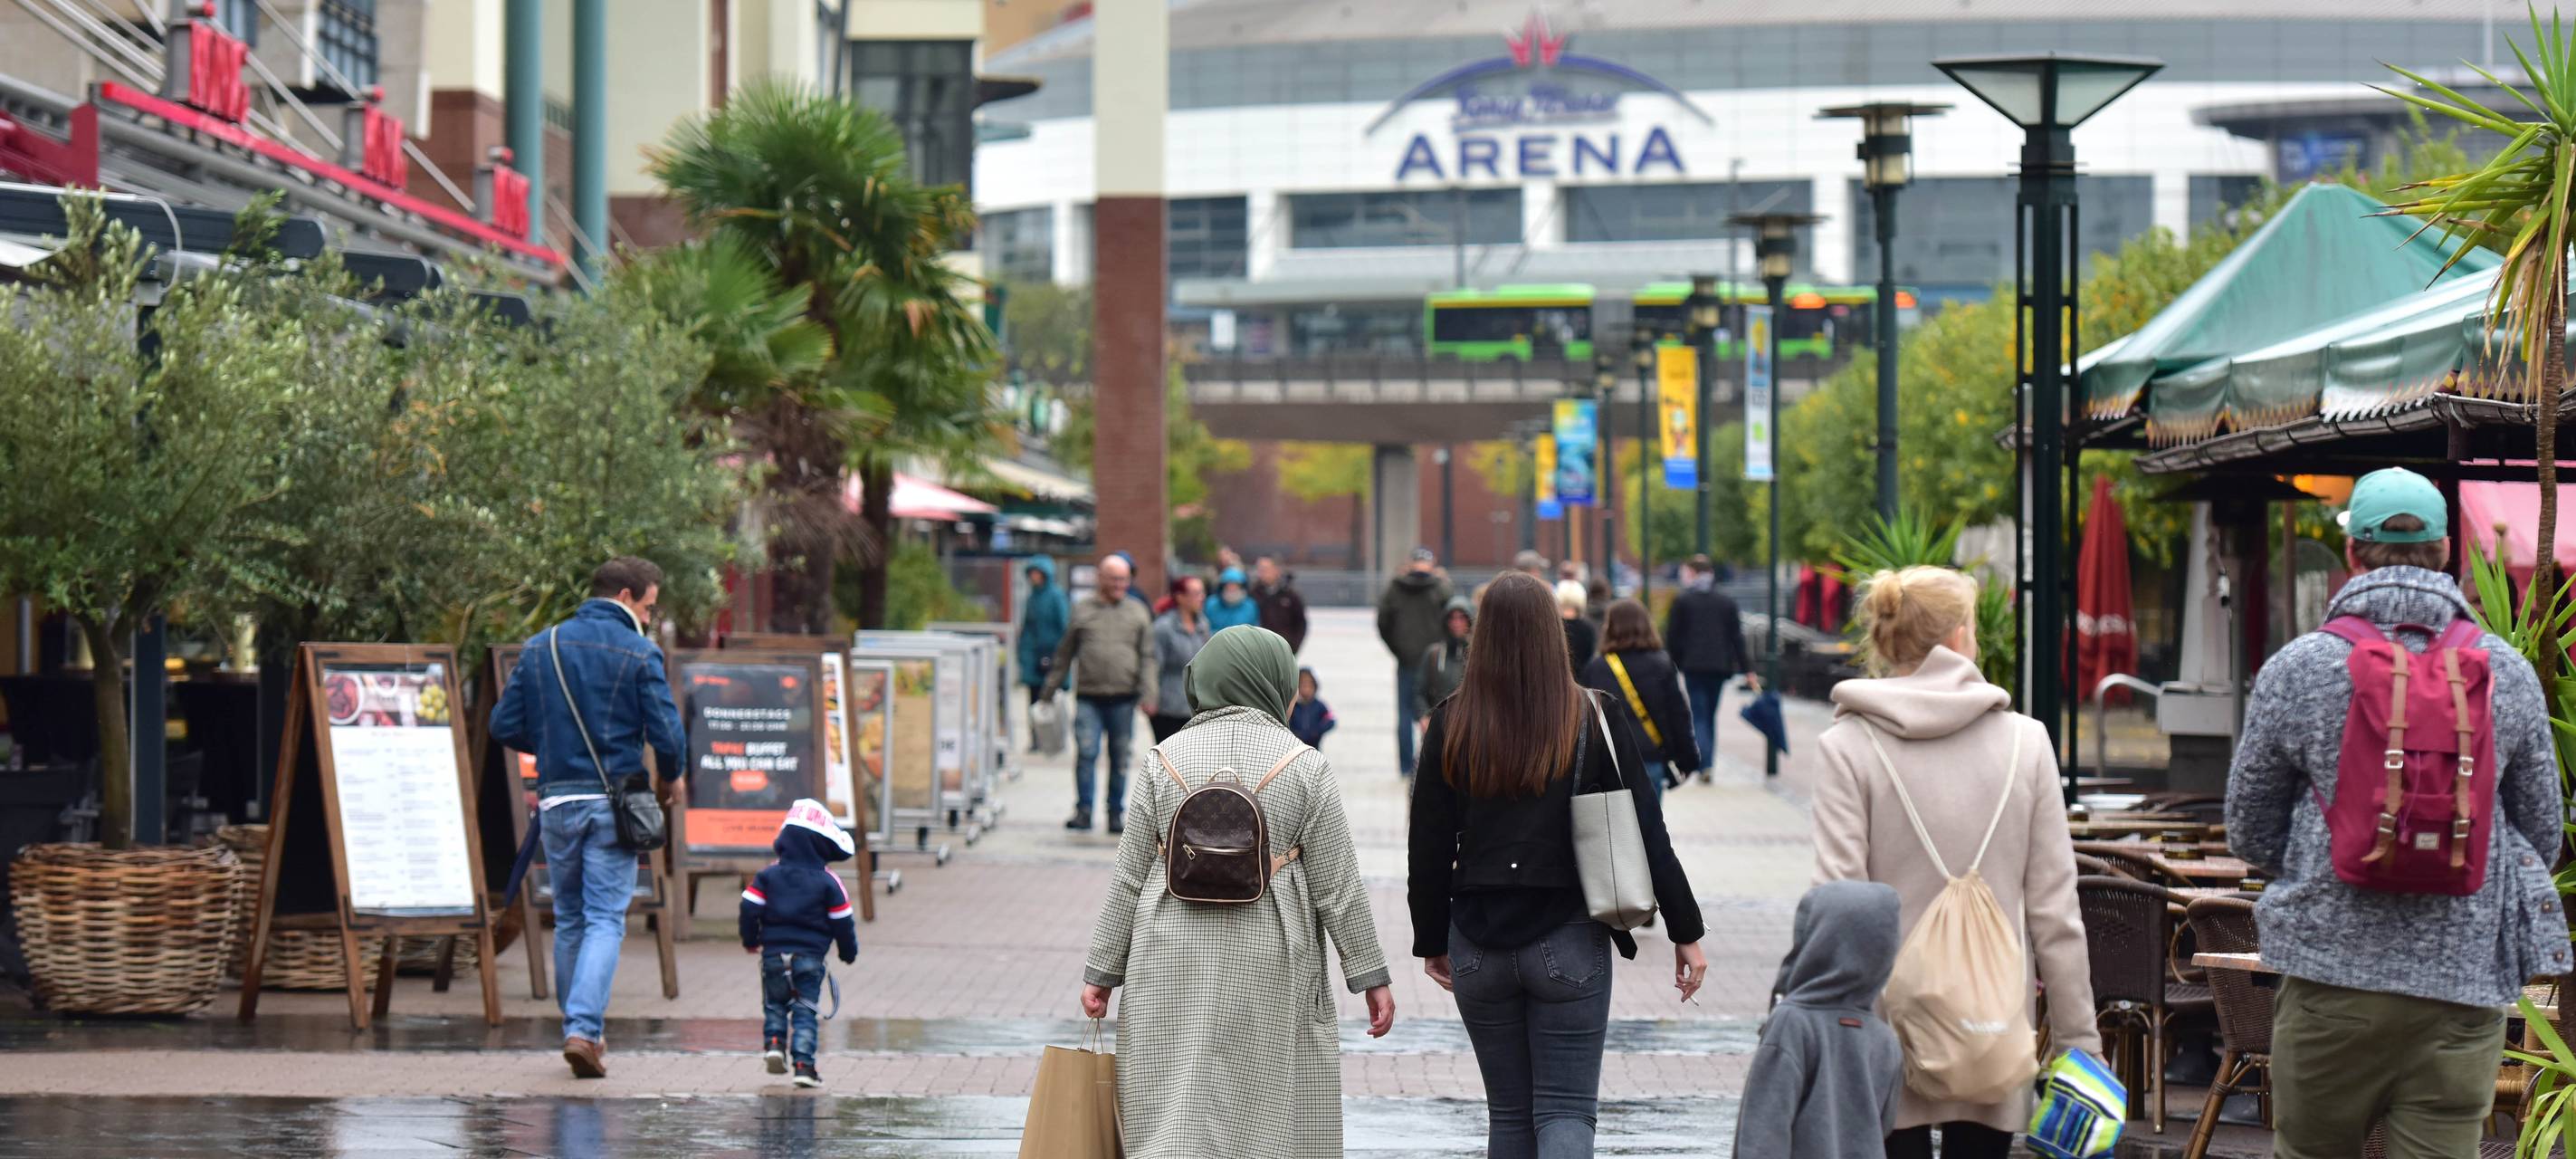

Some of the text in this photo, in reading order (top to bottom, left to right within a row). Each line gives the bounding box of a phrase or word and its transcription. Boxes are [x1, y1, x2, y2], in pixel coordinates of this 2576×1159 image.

[1395, 125, 1685, 180] ARENA
[746, 742, 787, 756] BUFFET
[701, 754, 797, 771] ALL YOU CAN EAT
